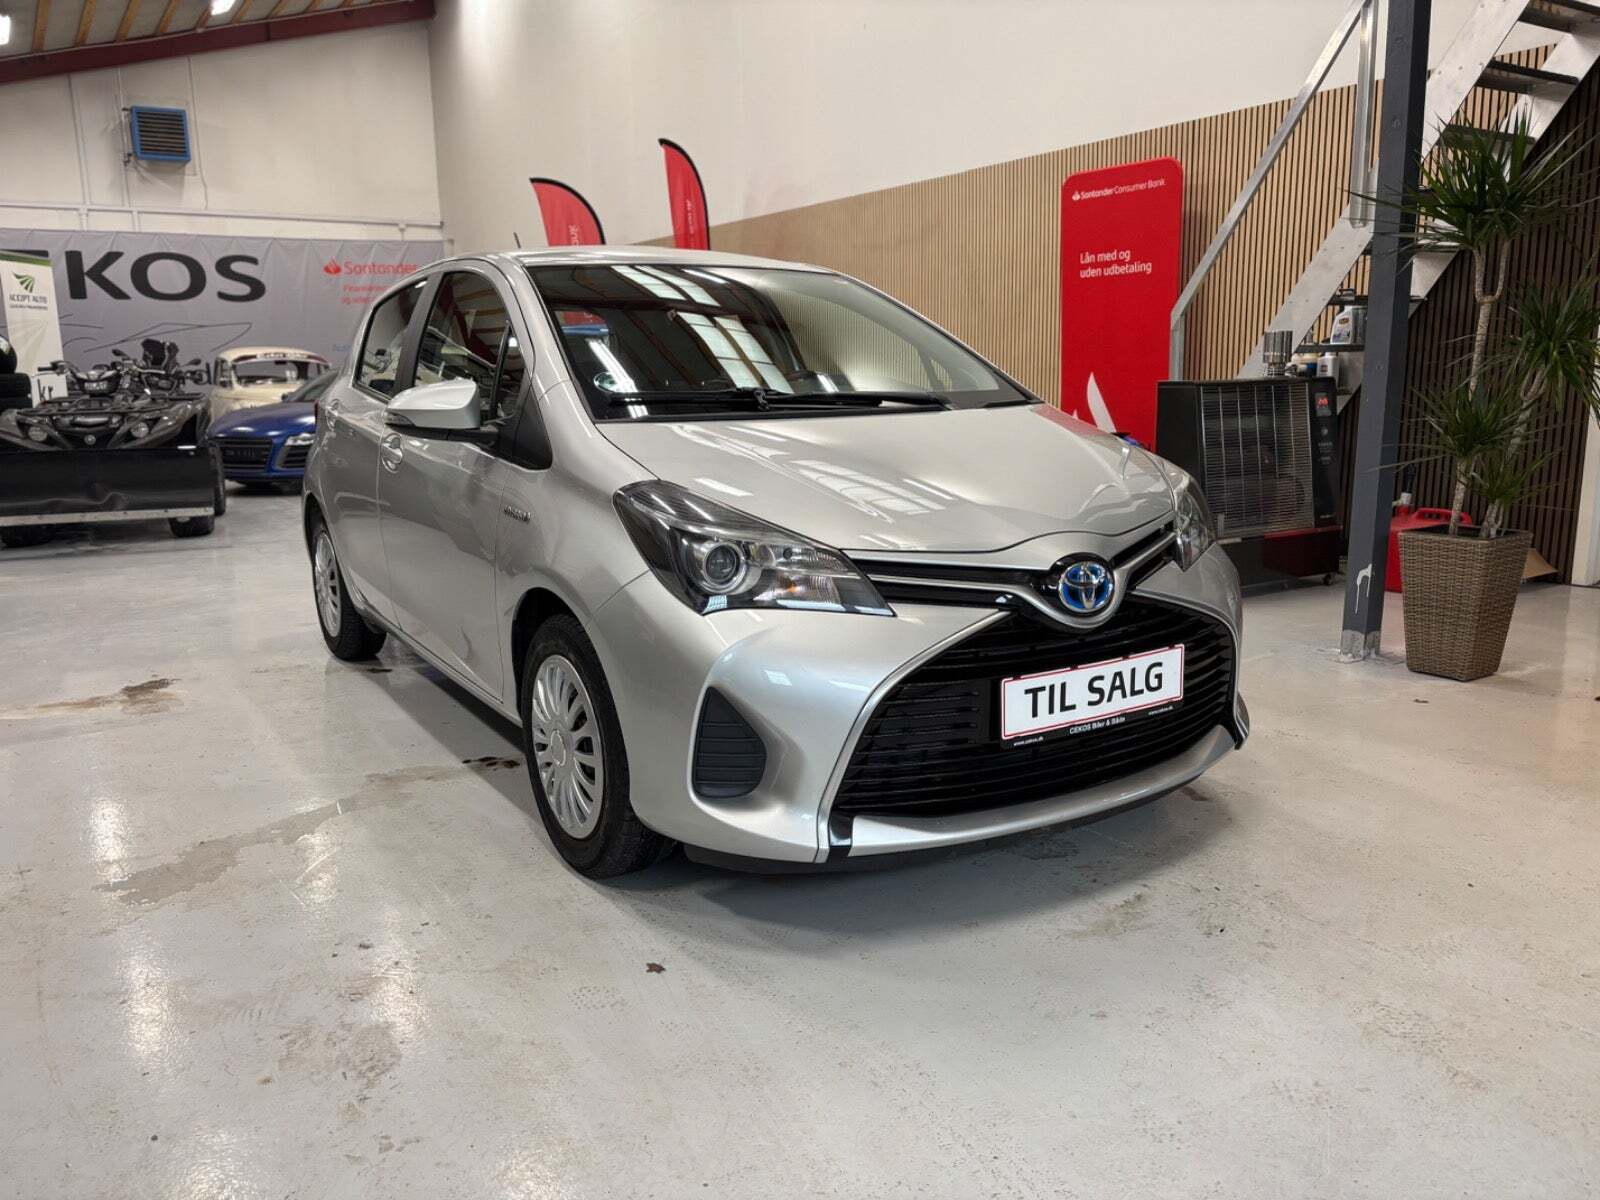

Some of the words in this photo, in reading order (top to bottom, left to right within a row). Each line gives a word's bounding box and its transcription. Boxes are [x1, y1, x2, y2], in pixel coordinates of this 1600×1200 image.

[1080, 187, 1114, 200] Santander
[1114, 181, 1147, 194] Consumer
[1147, 178, 1166, 189] Bank
[1080, 251, 1096, 264] Lån
[1097, 249, 1117, 262] med
[1118, 250, 1131, 262] og
[1080, 267, 1102, 278] uden
[1103, 262, 1152, 275] udbetaling
[1024, 681, 1077, 718] TIL
[1087, 661, 1163, 706] SALG
